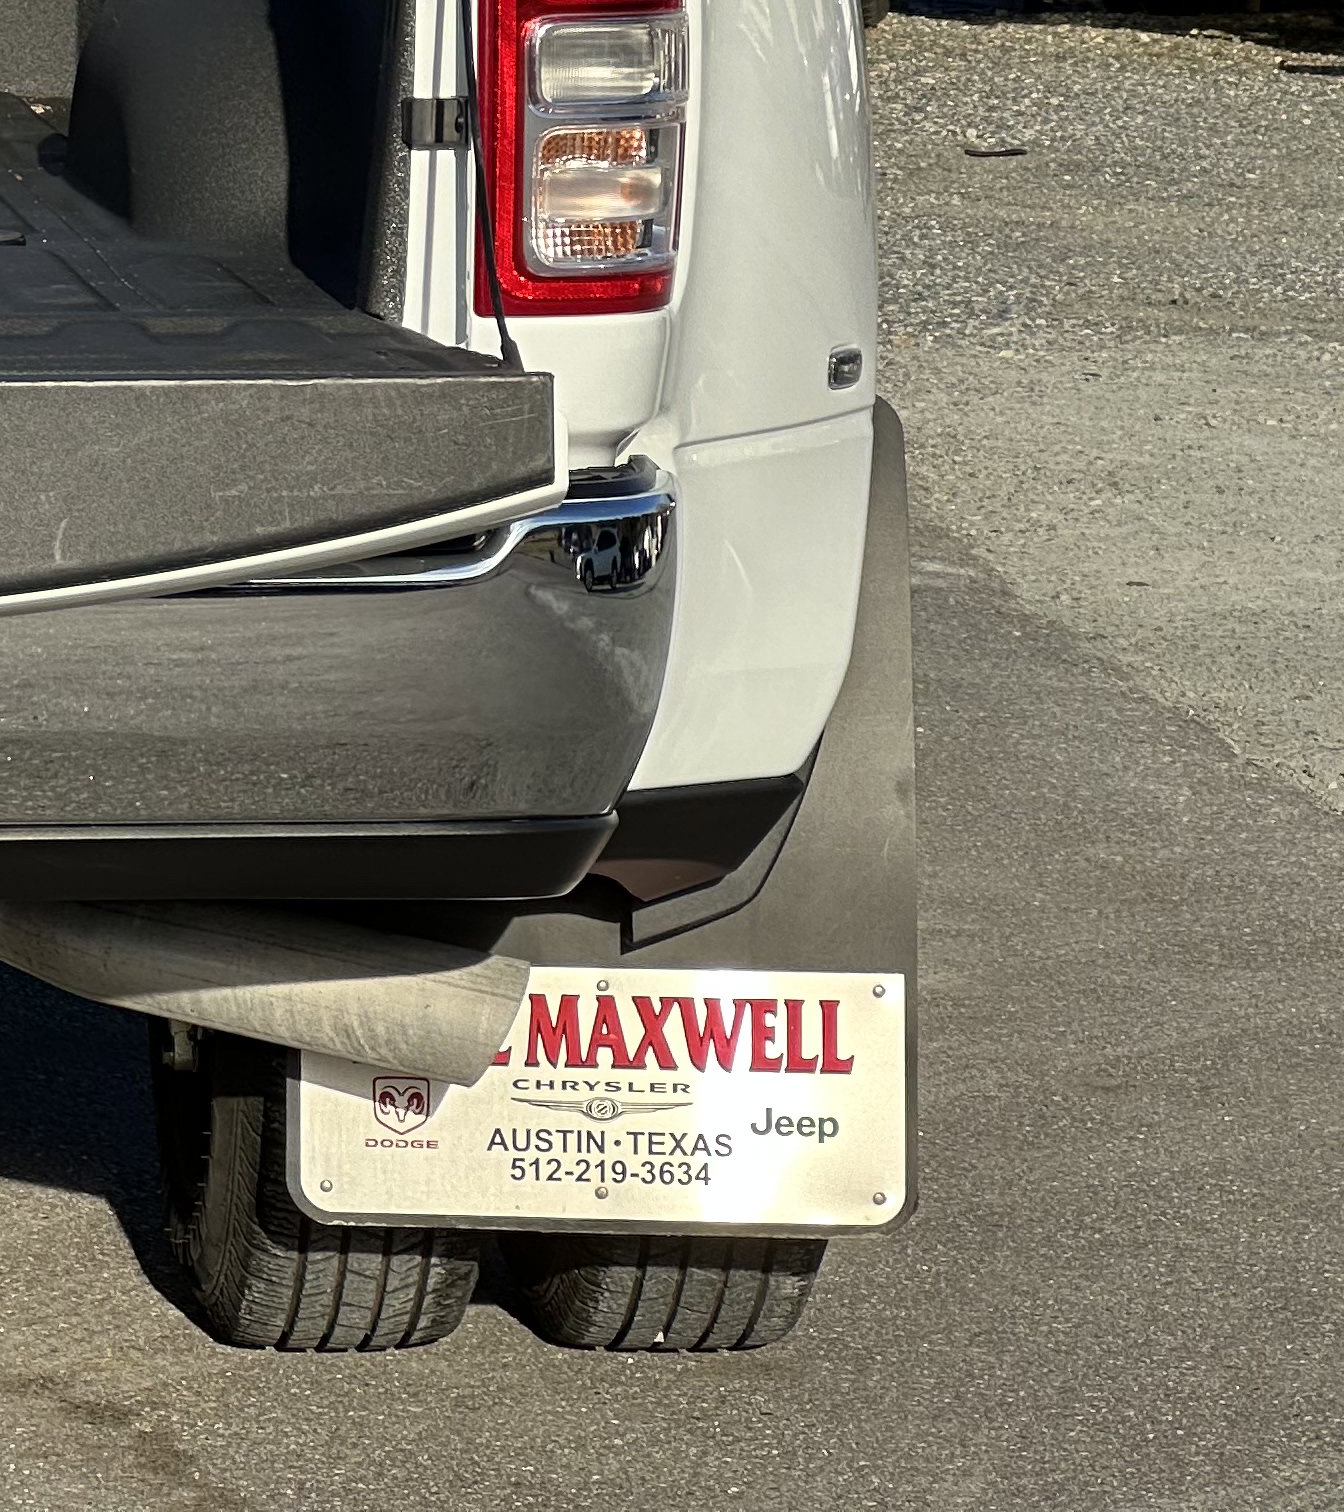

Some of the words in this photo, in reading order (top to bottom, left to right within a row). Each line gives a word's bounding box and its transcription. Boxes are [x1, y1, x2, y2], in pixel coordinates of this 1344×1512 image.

[526, 993, 855, 1075] MAXWELL
[512, 1078, 691, 1094] CHRYSLER
[750, 1108, 840, 1144] Jeep
[364, 1139, 440, 1150] DODGE
[486, 1128, 606, 1155] AUSTIN
[625, 1132, 733, 1158] TEXAS
[509, 1159, 712, 1186] 512-219-3634
